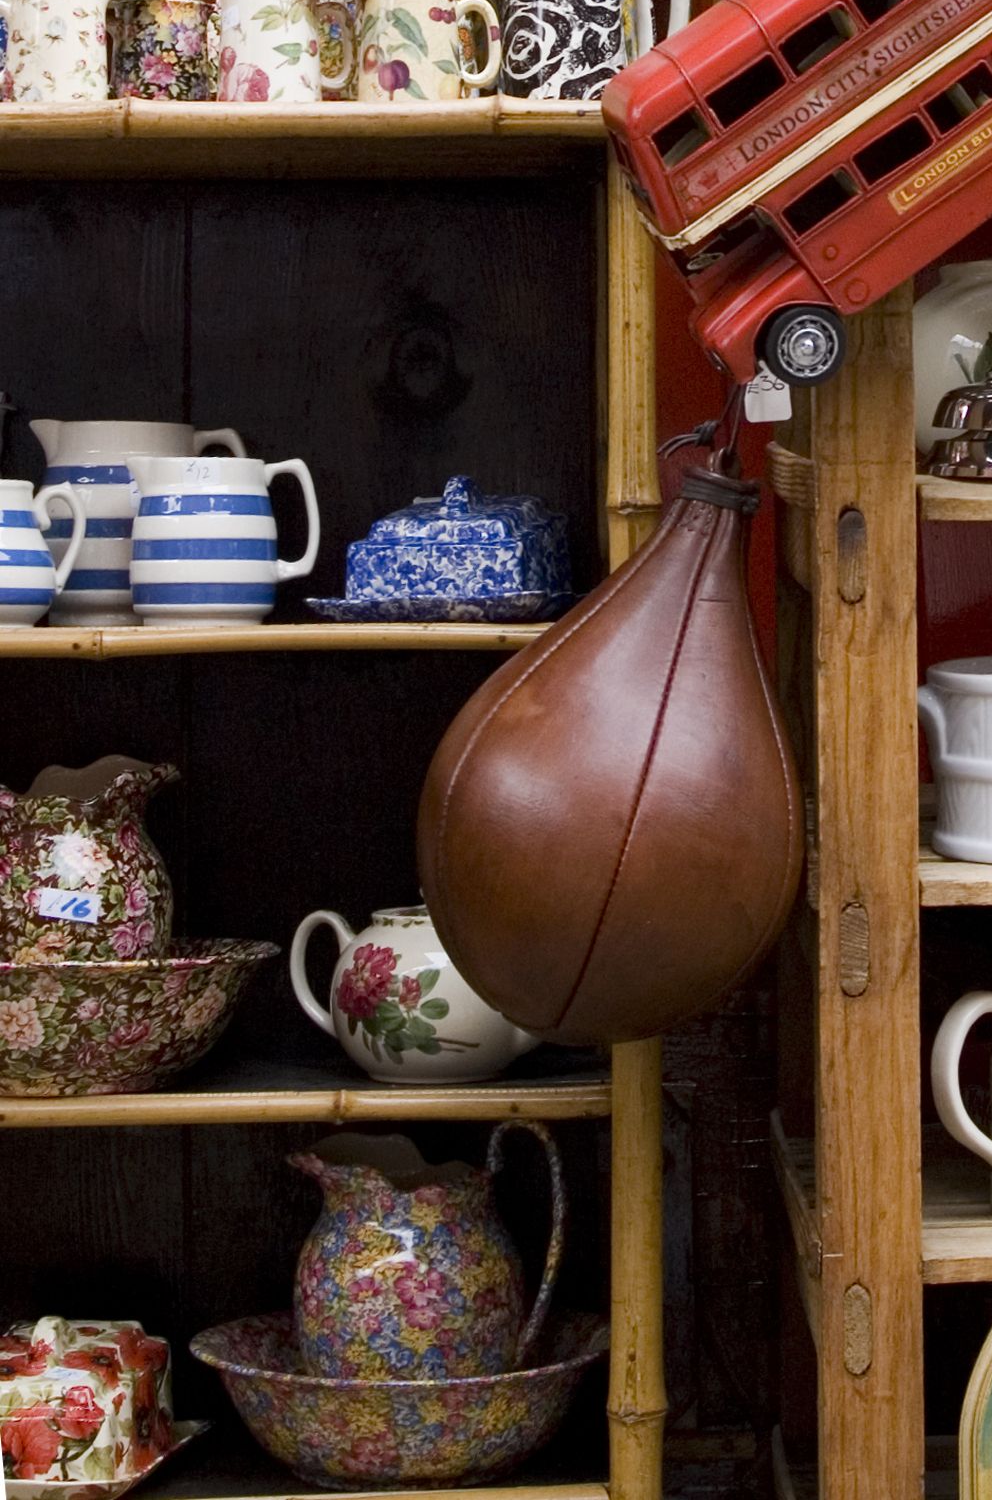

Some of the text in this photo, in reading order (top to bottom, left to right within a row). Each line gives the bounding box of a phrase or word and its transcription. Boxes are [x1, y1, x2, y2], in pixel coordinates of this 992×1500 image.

[736, 90, 825, 164] LONDON
[824, 61, 873, 102] CITY
[900, 145, 971, 202] LONDON
